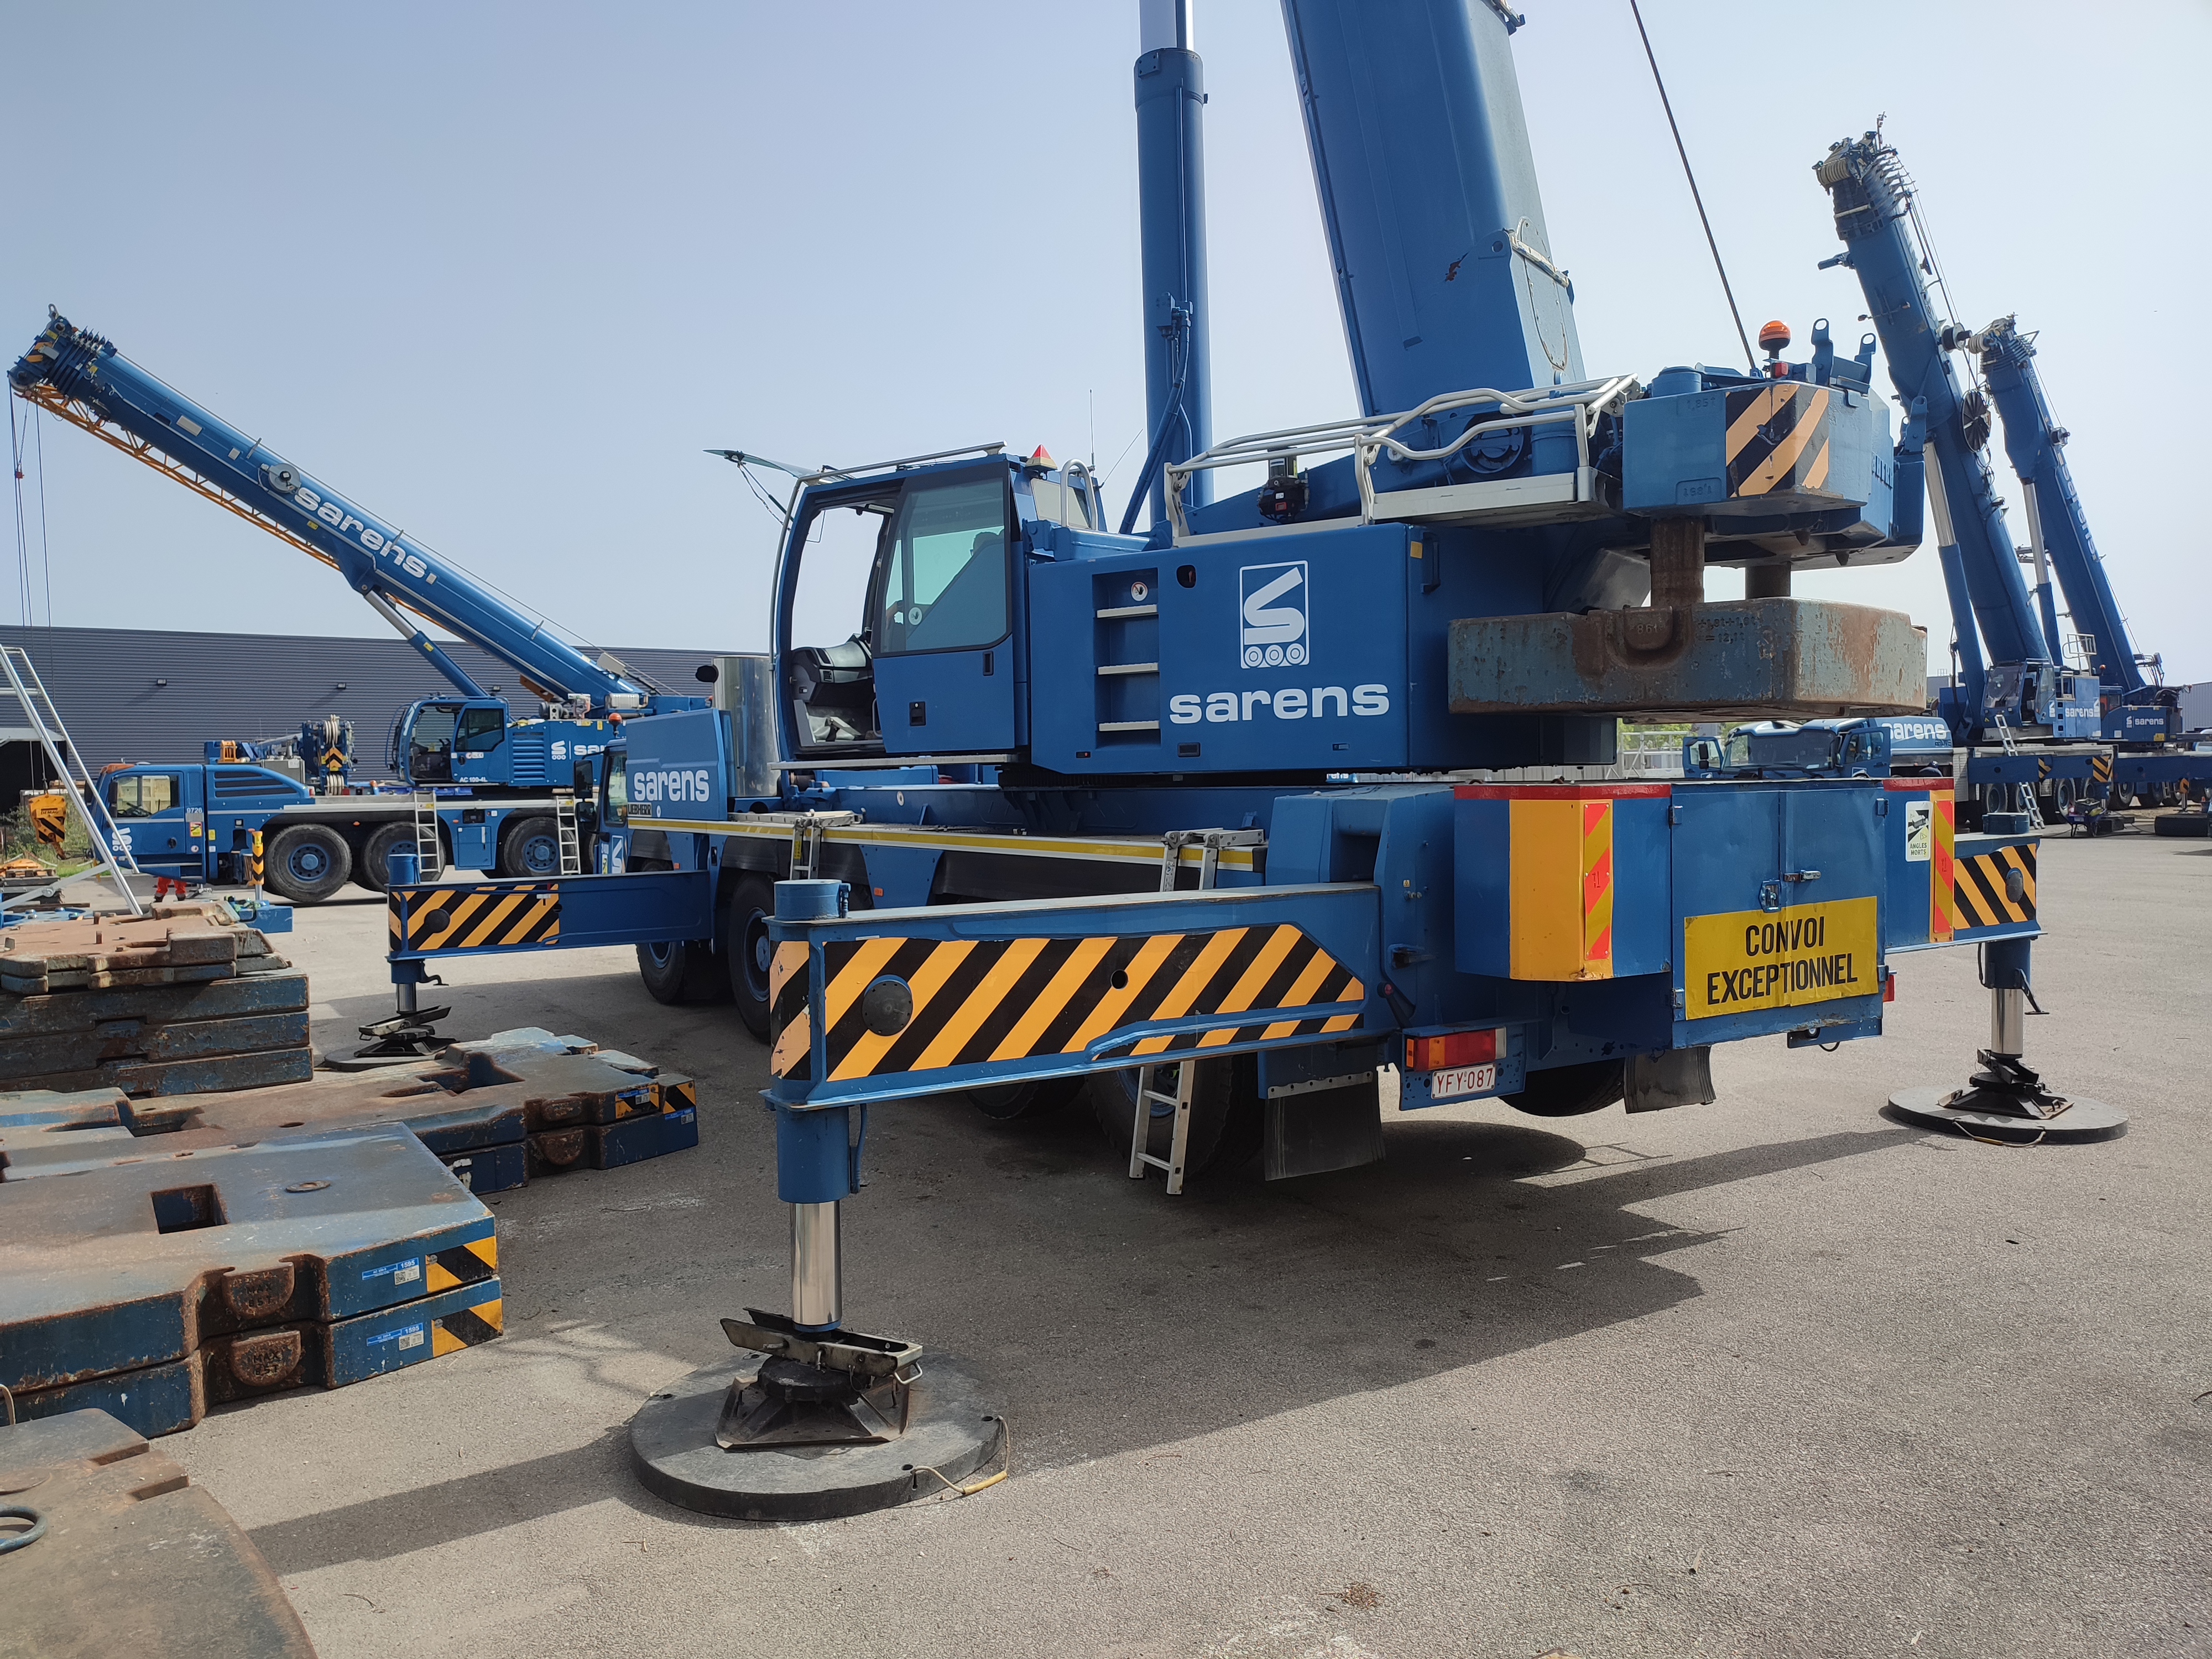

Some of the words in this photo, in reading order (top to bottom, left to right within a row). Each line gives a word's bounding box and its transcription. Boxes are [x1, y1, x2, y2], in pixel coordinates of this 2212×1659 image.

[294, 487, 427, 578] sarens
[1169, 684, 1390, 724] sarens
[2065, 708, 2094, 718] sarens
[634, 769, 709, 802] sarens
[1745, 916, 1824, 957] CONVOI
[1707, 952, 1858, 1005] EXCEPTIONNEL
[1437, 1067, 1493, 1094] YFY-087
[400, 1260, 415, 1269] 1595
[405, 1325, 420, 1334] 1595
